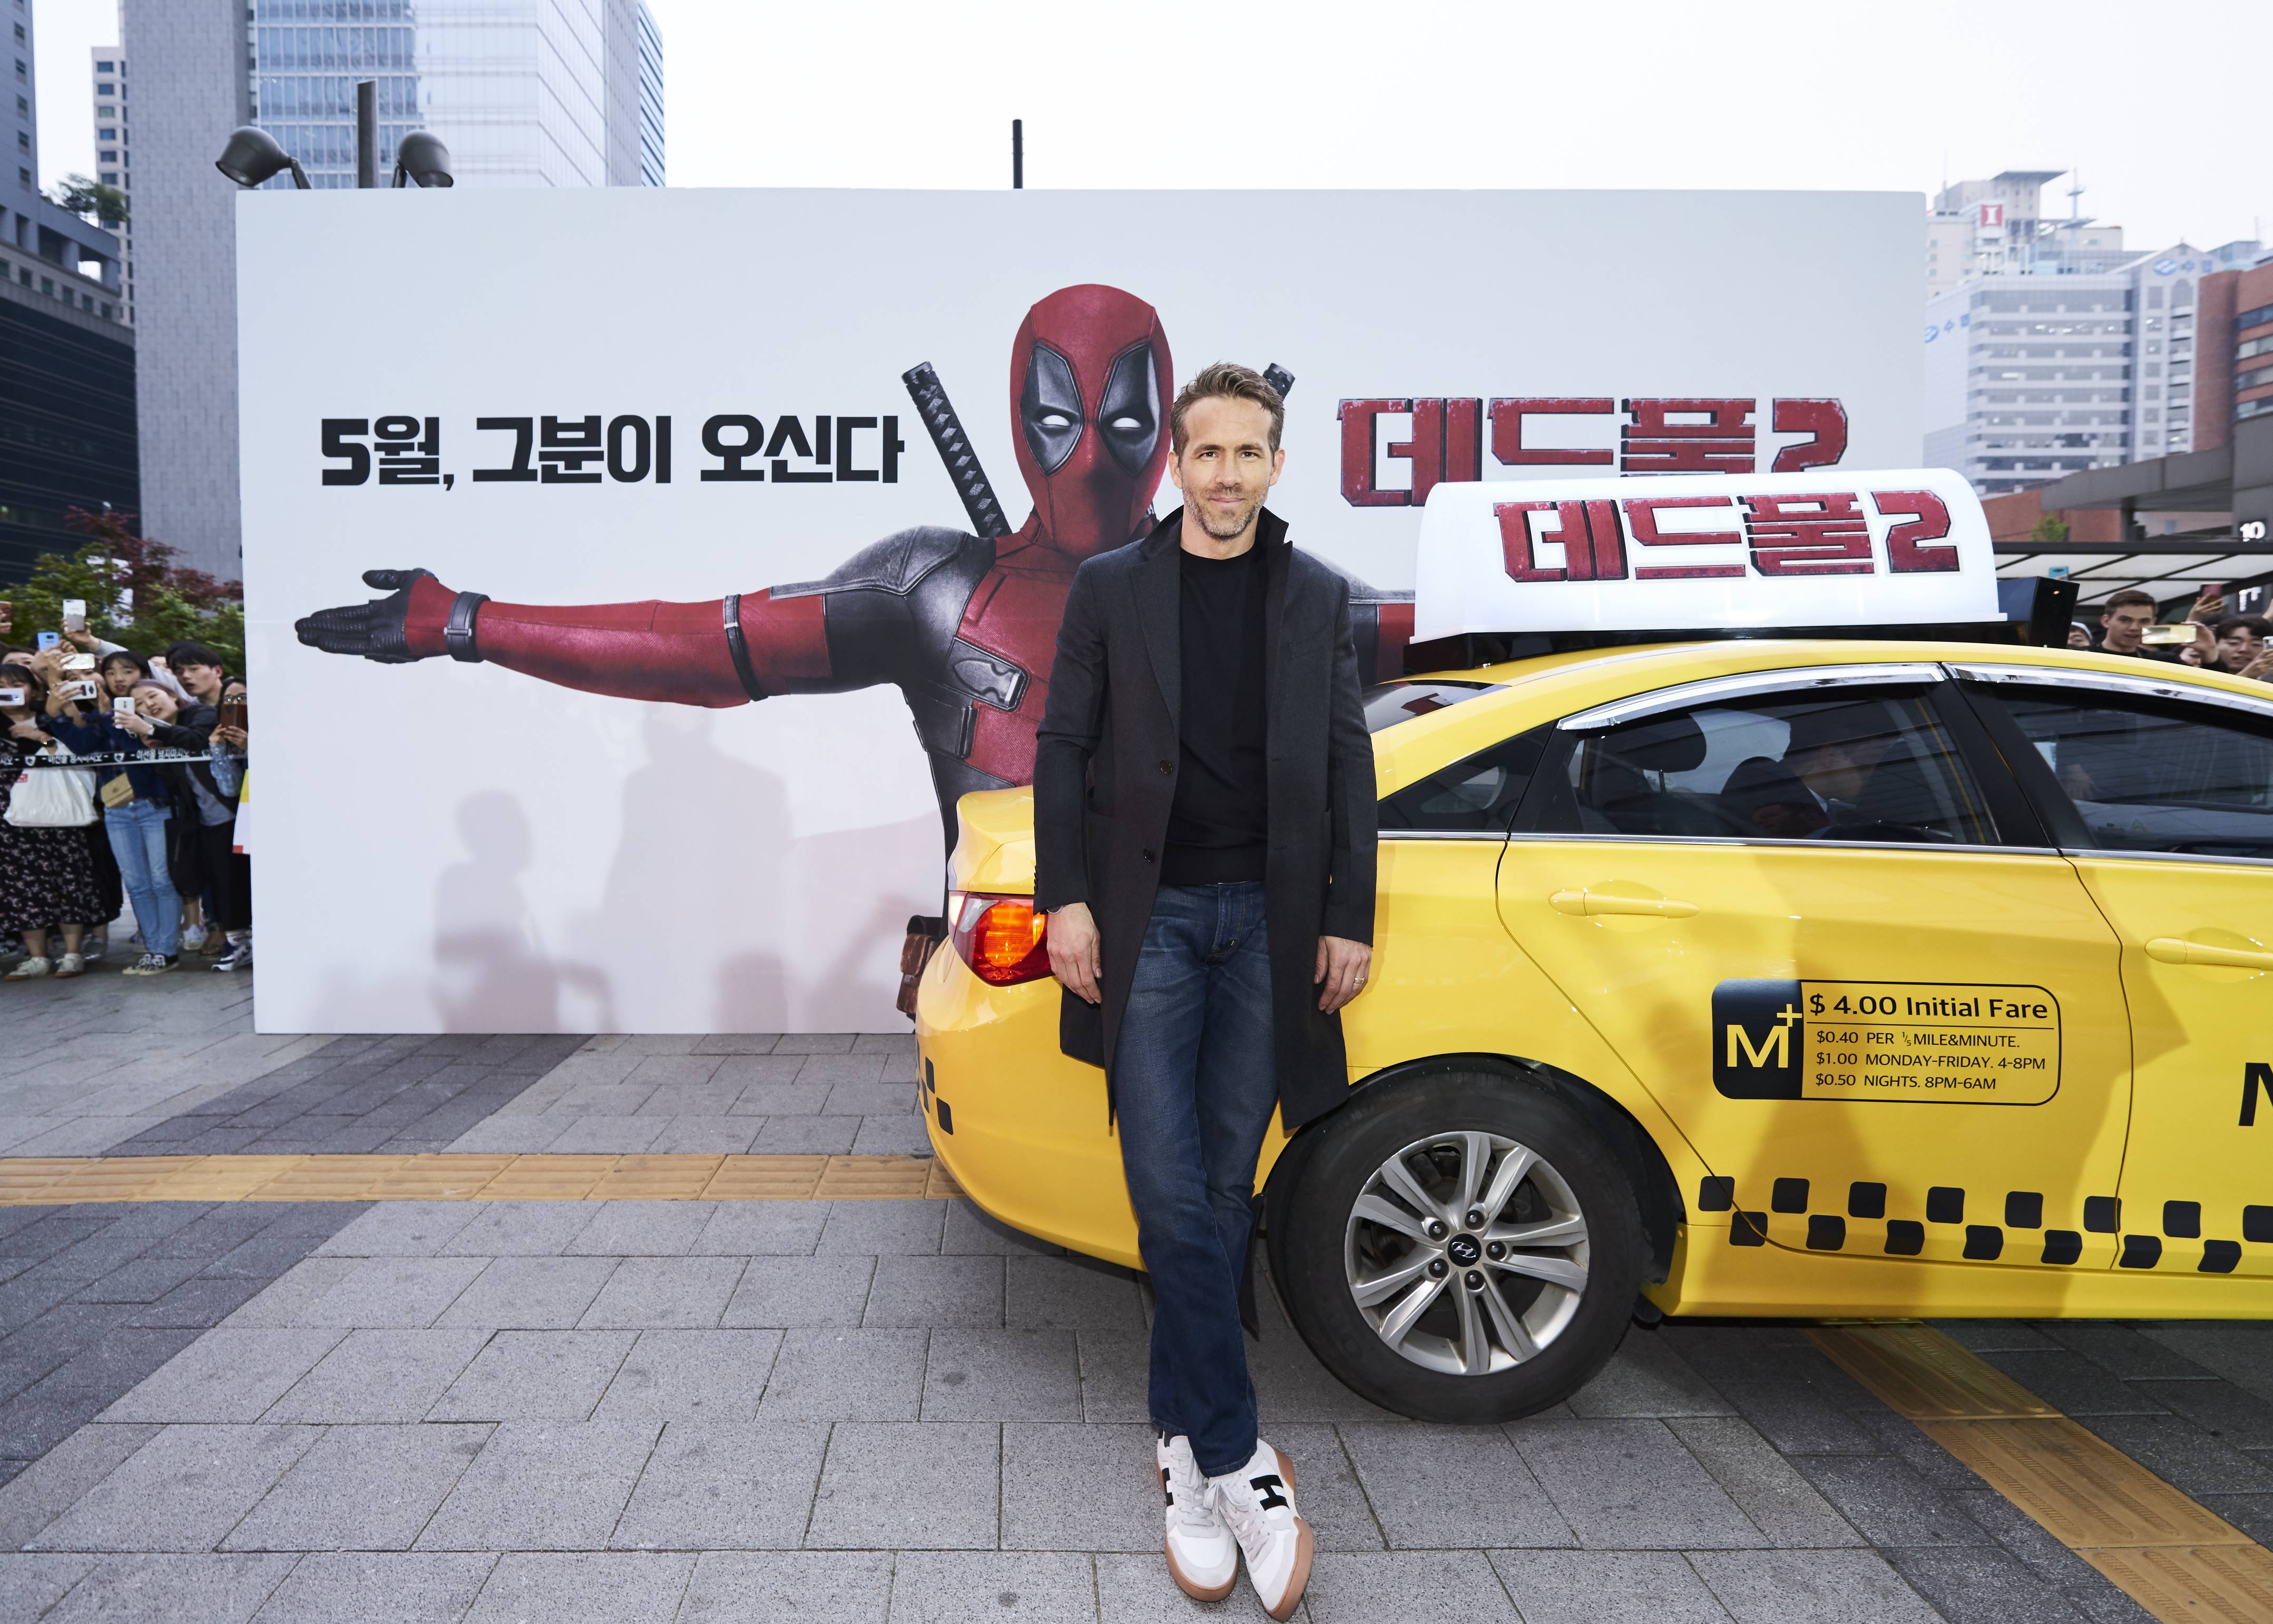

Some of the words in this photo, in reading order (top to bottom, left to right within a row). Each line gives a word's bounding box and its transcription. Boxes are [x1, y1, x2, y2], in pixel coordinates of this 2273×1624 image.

[322, 415, 454, 491] 5월,
[473, 415, 671, 484] 그분이
[700, 414, 905, 484] 오신다
[1493, 489, 1961, 583] 데드풀2
[1906, 997, 1980, 1017] Initial
[1989, 999, 2048, 1019] Fare
[1817, 1030, 1858, 1044] $0.40
[1867, 1032, 1894, 1044] PER
[1816, 1051, 1858, 1065] $1.00
[1866, 1053, 1994, 1069] MONDAY-FRIDAY.
[1997, 1057, 2045, 1070] 4-8PM
[1815, 1072, 1856, 1087] $0.50
[1864, 1075, 1921, 1088] NIGHTS.
[1925, 1076, 1996, 1090] 8PM-6AM
